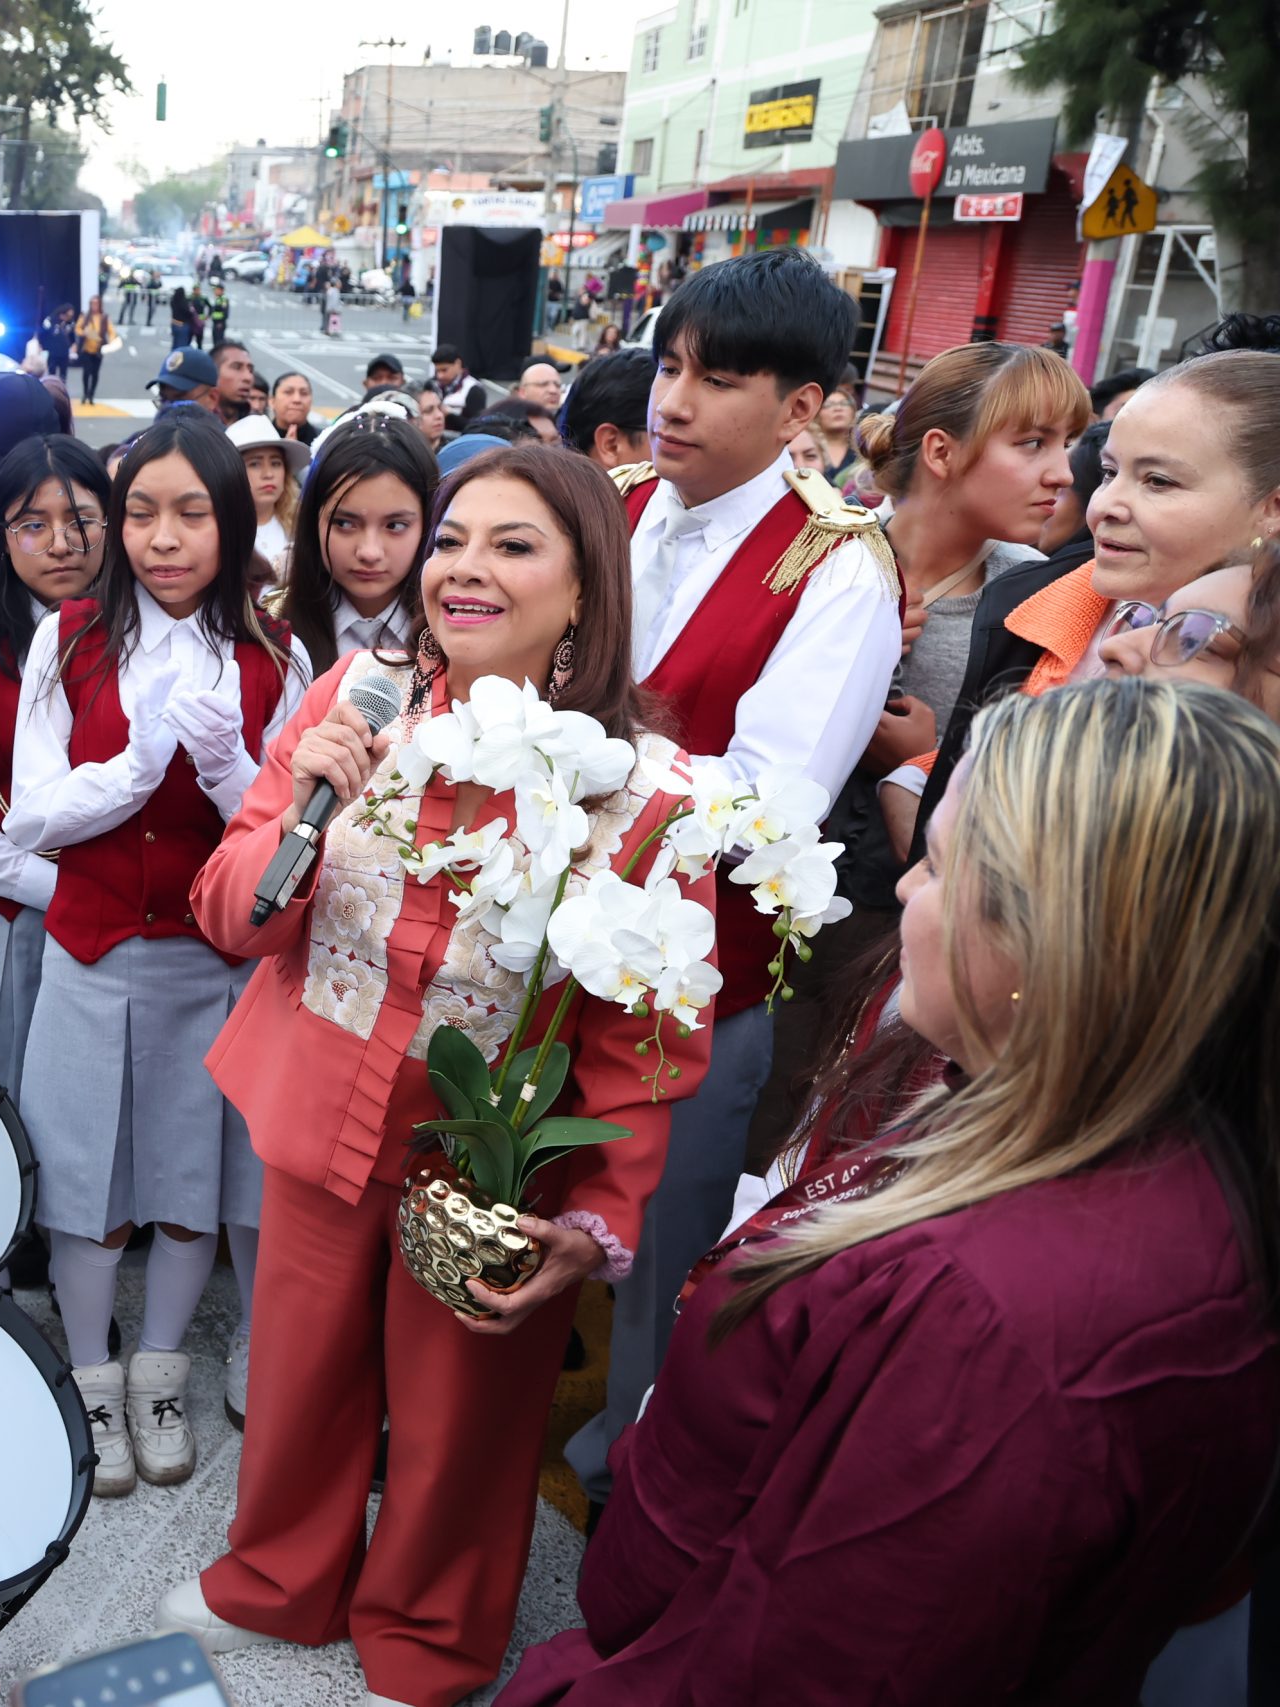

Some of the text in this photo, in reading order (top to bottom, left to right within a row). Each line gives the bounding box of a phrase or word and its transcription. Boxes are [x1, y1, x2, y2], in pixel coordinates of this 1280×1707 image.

[950, 133, 985, 156] Abts.
[944, 164, 962, 187] La
[962, 162, 1026, 186] Mexicana
[804, 1172, 836, 1200] EST
